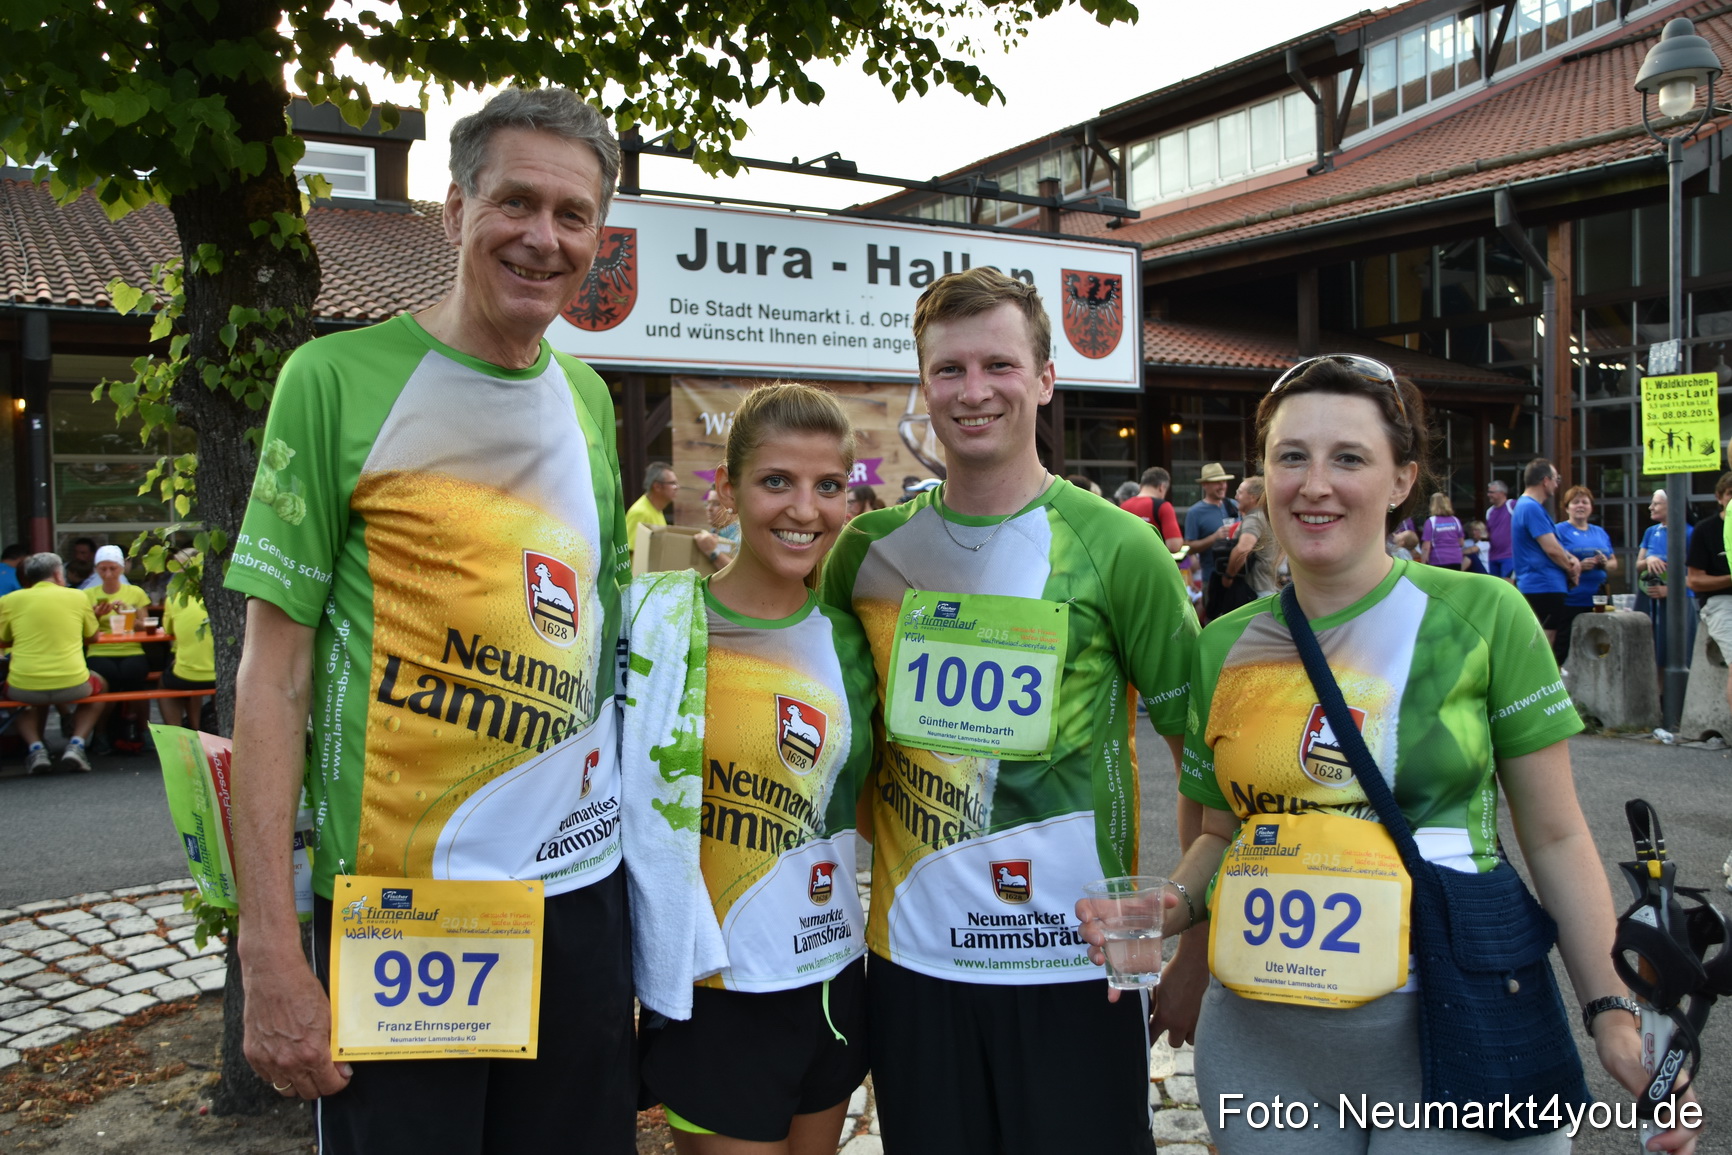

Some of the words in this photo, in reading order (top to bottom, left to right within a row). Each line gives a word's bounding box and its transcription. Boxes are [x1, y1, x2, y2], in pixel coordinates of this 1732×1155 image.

[676, 227, 813, 279] Jura
[832, 261, 847, 271] -
[670, 298, 699, 315] Die
[706, 300, 753, 318] Stadt
[758, 304, 840, 325] Neumarkt
[846, 309, 855, 325] i.
[861, 310, 874, 326] d.
[646, 323, 681, 338] und
[688, 325, 764, 343] wünscht
[770, 328, 817, 345] Ihnen
[823, 332, 867, 349] einen
[1655, 378, 1713, 389] Waldkirchen-
[1645, 388, 1714, 401] Cross-Lauf
[1663, 408, 1714, 420] 08.08.2015
[541, 619, 568, 640] 1628
[922, 615, 978, 630] firmenlauf
[977, 627, 1010, 641] 2015
[907, 652, 1042, 717] 1003
[918, 715, 959, 730] Günther
[960, 721, 1014, 737] Membarth
[927, 730, 957, 740] Neumarkter
[957, 732, 991, 745] Lammsbräu
[786, 750, 807, 770] 1628
[1312, 762, 1343, 780] 1628
[1242, 843, 1301, 857] firmenlauf
[1302, 853, 1341, 866] 2015
[1226, 863, 1268, 877] walken
[367, 907, 439, 921] firmenlauf
[967, 911, 1066, 926] Neumarkter
[1243, 887, 1362, 954] 992
[440, 917, 479, 929] 2015
[345, 925, 403, 940] walken
[950, 926, 1088, 949] Lammsbräu
[953, 956, 1090, 969] www.lammsbraeu.de
[1265, 961, 1284, 973] Ute
[1286, 963, 1326, 977] Walter
[374, 950, 500, 1007] 997
[1254, 977, 1286, 986] Neumarkter
[1287, 979, 1325, 989] Lammsbräu
[377, 1021, 412, 1032] Franz
[414, 1020, 491, 1033] Ehrnsperger
